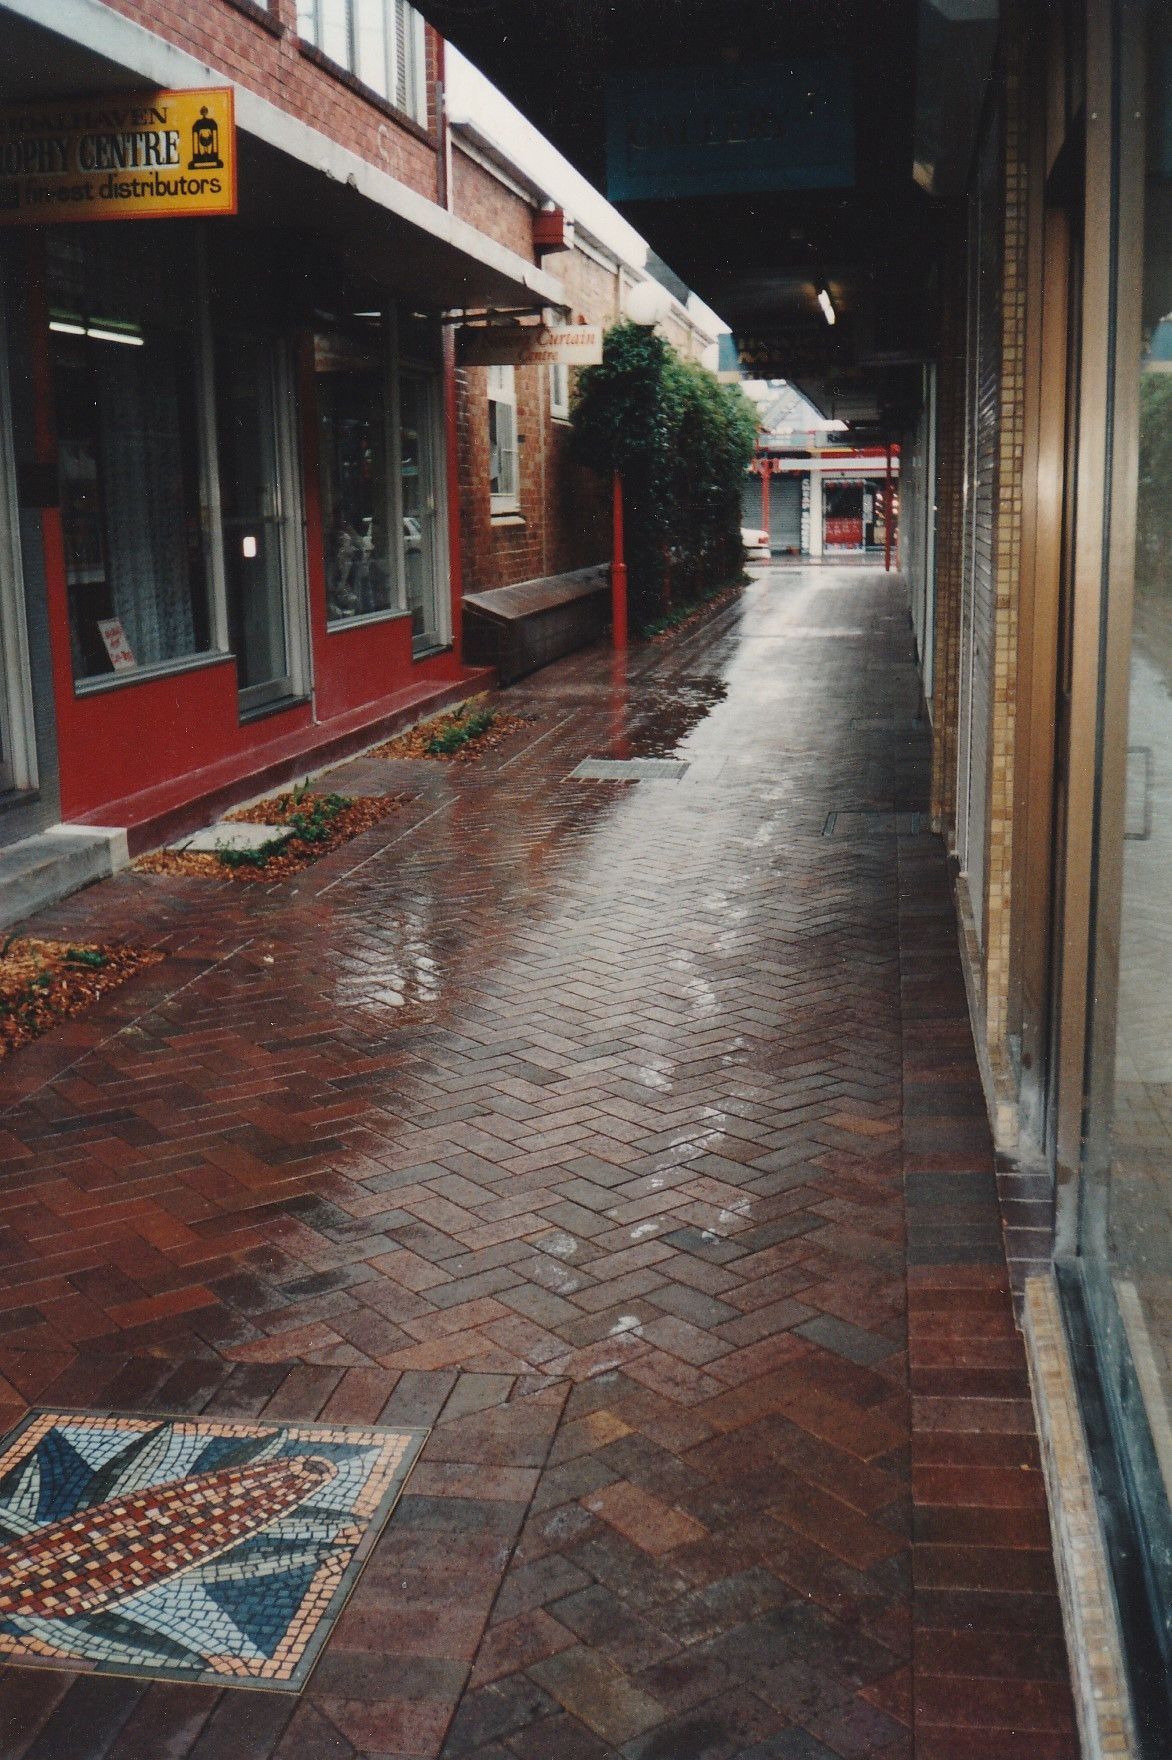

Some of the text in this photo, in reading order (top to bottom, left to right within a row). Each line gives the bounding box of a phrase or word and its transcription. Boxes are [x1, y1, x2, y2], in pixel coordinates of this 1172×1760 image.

[78, 130, 181, 171] CENTRE
[100, 171, 222, 199] distributors
[536, 325, 596, 346] Curtain
